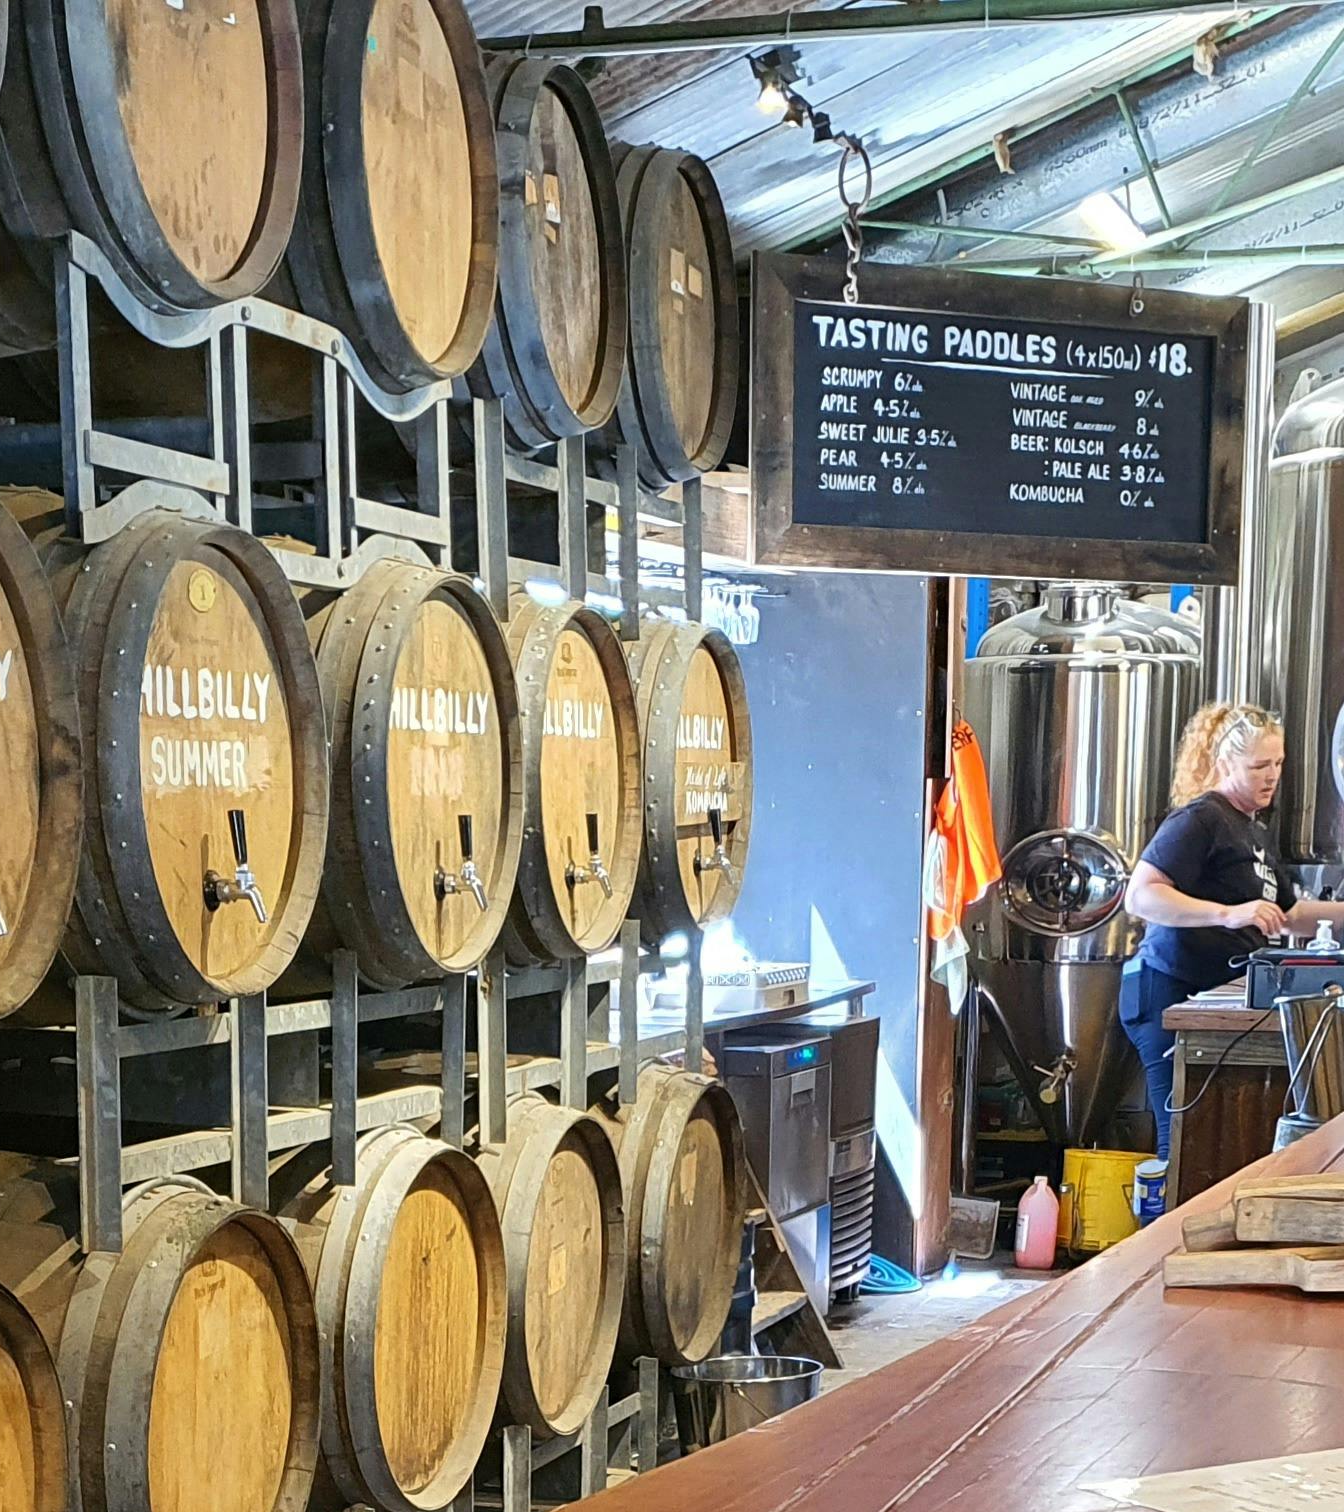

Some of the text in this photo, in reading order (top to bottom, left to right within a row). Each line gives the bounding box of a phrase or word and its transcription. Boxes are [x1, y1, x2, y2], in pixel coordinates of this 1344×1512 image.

[812, 315, 928, 354] TASTING
[944, 326, 1056, 364] PADDLES
[821, 366, 883, 389] SCRUMPY
[1010, 381, 1067, 403] VINTAGE
[820, 393, 858, 414] APPLE
[1012, 407, 1068, 429] VINTAGE
[817, 421, 867, 441] SWEET
[872, 425, 910, 445] JULIE
[1010, 433, 1049, 452] BEER:
[1054, 437, 1104, 455] KOLSCH
[820, 448, 858, 467] PEAR
[818, 472, 877, 492] SUMMER
[1087, 463, 1111, 481] ALE
[1009, 484, 1084, 504] KOMBUCHA
[140, 663, 270, 724] HILLBILLY
[389, 686, 488, 736] HILLBILLY
[542, 697, 603, 739] ILLBILLY
[676, 713, 724, 750] ILLBILLY
[151, 735, 247, 789] SUMMER
